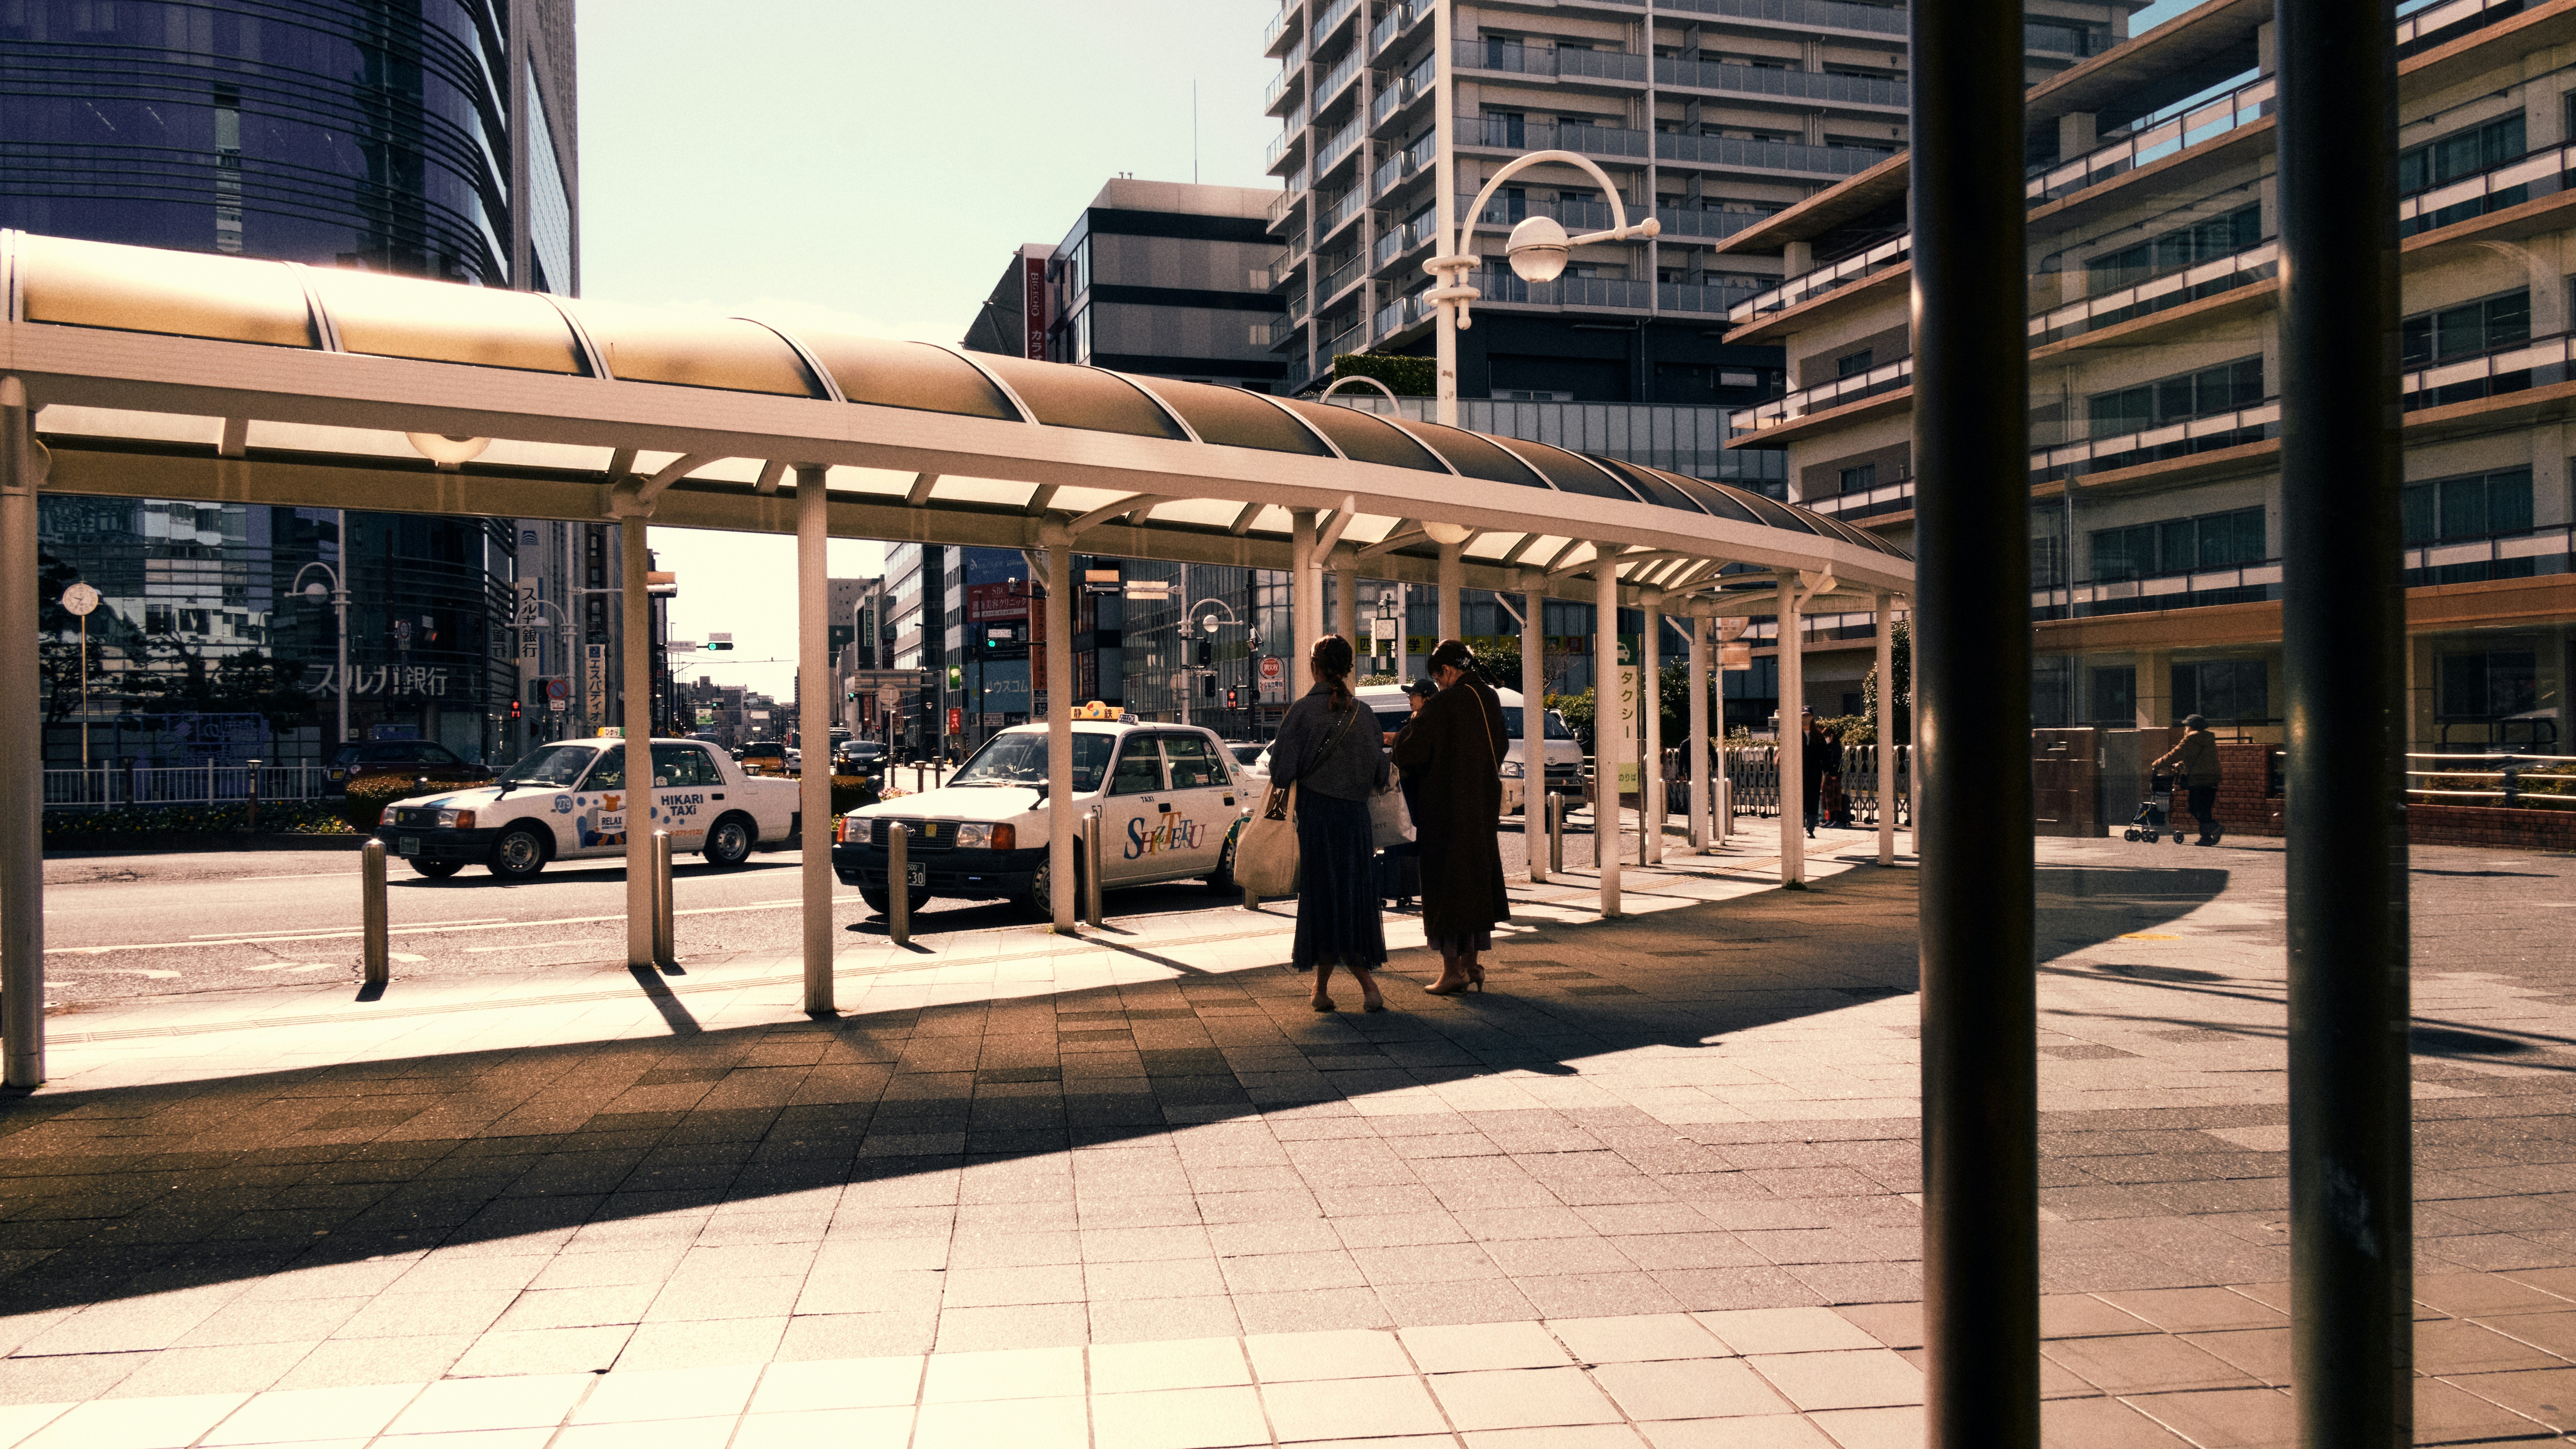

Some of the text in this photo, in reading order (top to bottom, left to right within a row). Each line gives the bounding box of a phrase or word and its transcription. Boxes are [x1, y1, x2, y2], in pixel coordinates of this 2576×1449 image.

[1031, 273, 1039, 316] BIG ECHO
[992, 586, 1005, 595] SBC
[590, 660, 602, 721] エスパティオ
[1621, 671, 1633, 738] タクシー
[1074, 708, 1112, 718] 静 鉄
[1619, 773, 1637, 782] のりば
[557, 798, 572, 810] 279
[662, 794, 704, 806] HIKARI
[671, 805, 697, 816] TAXi
[1092, 805, 1102, 818] 57
[602, 817, 623, 826] RELAX
